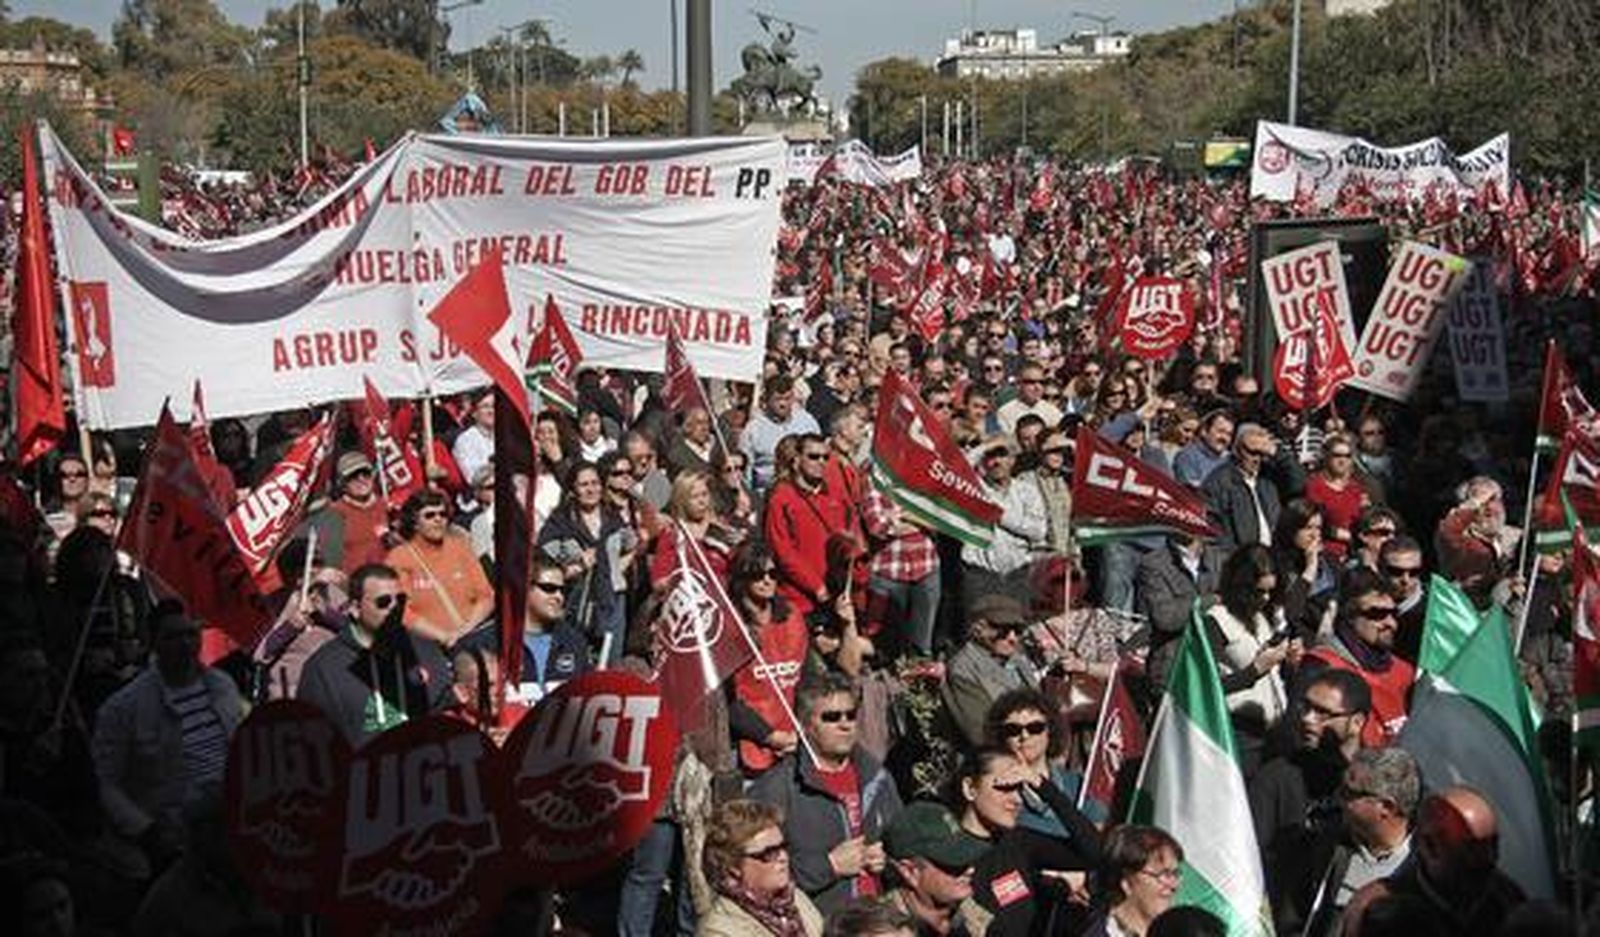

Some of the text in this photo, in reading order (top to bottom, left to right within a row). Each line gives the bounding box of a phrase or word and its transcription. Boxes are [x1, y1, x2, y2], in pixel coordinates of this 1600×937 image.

[385, 163, 504, 203] LABORAL
[524, 165, 577, 195] DEL
[594, 165, 650, 196] GOB
[664, 166, 717, 198] DEL
[336, 247, 447, 286] HUELGA
[1271, 250, 1334, 295] UGT
[1398, 250, 1459, 297] UGT
[1128, 283, 1183, 318] UGT
[1382, 287, 1445, 333] UGT
[1451, 298, 1491, 328] UGT
[273, 329, 378, 371] AGRUP
[581, 303, 753, 347] RINCONADA
[1365, 322, 1430, 367] UGT
[1454, 333, 1497, 366] UGT
[234, 468, 302, 534] UGT
[517, 694, 661, 779] UGT
[240, 719, 335, 801] UGT
[344, 731, 486, 858] UGT
